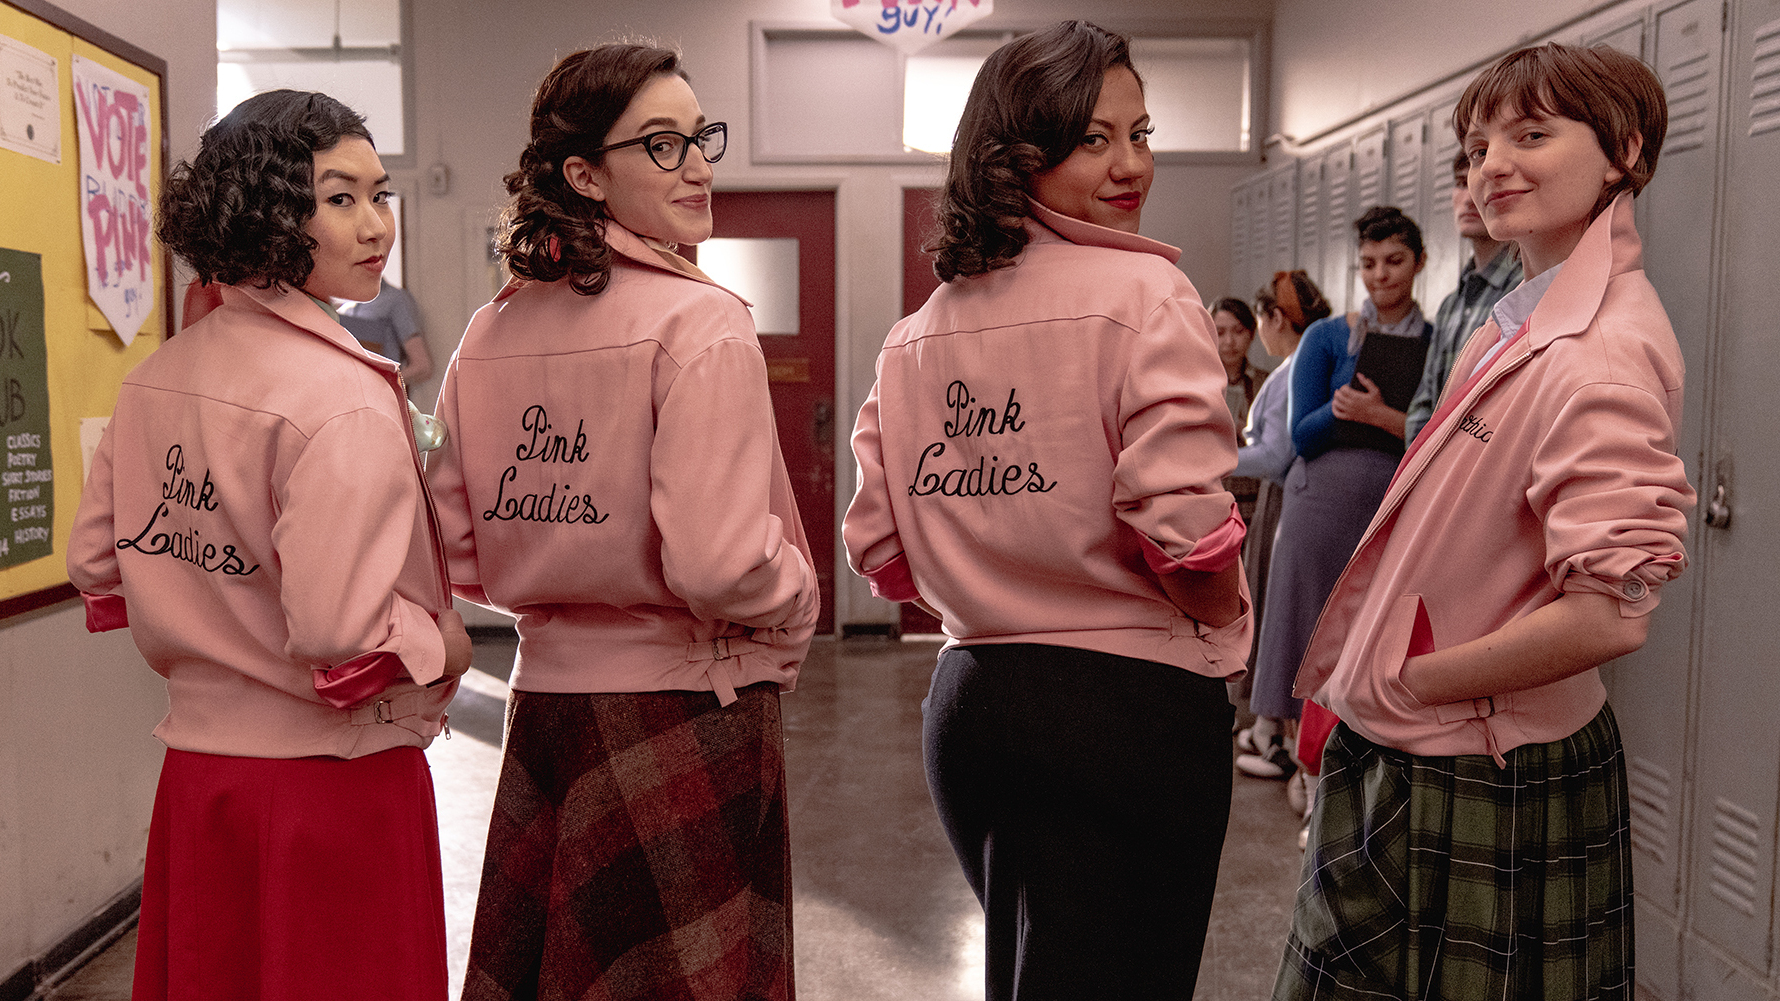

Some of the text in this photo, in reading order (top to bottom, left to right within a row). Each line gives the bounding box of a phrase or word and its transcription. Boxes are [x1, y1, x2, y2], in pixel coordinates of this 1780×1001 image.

[76, 82, 147, 200] VOTE
[88, 194, 150, 282] PINK
[0, 308, 24, 360] K
[516, 405, 590, 464] Pink
[944, 380, 1026, 438] Pink
[6, 432, 41, 449] CLASSICS
[7, 452, 37, 468] POETRY
[2, 469, 52, 486] SHORT STORIES
[8, 486, 40, 502] FICTION
[163, 444, 219, 511] Pink
[483, 465, 610, 524] Ladies
[908, 442, 1058, 497] Ladies
[11, 505, 46, 521] ESSAYS
[14, 527, 49, 544] HISTORY
[116, 501, 260, 576] Ladies
